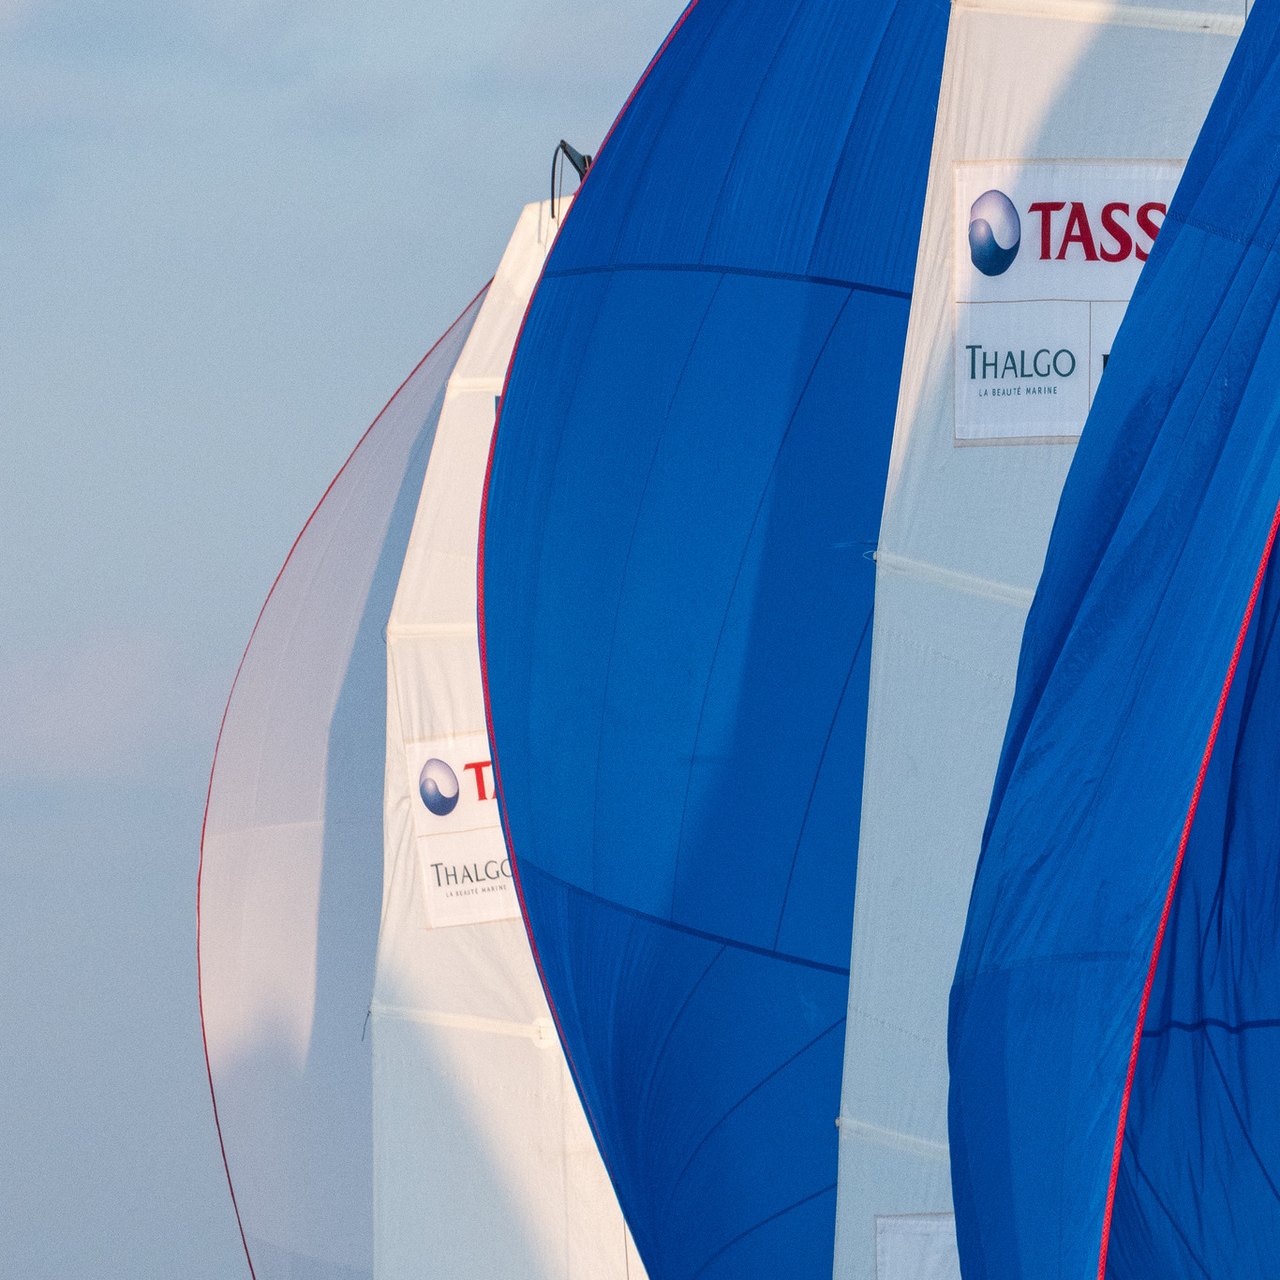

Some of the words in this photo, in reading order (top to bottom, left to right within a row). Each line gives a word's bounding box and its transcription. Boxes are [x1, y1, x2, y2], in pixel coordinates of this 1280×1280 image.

[965, 345, 1076, 380] THALGO
[978, 388, 988, 397] LA
[991, 386, 1021, 397] BEAUTÉ
[1025, 381, 1058, 396] MARINE
